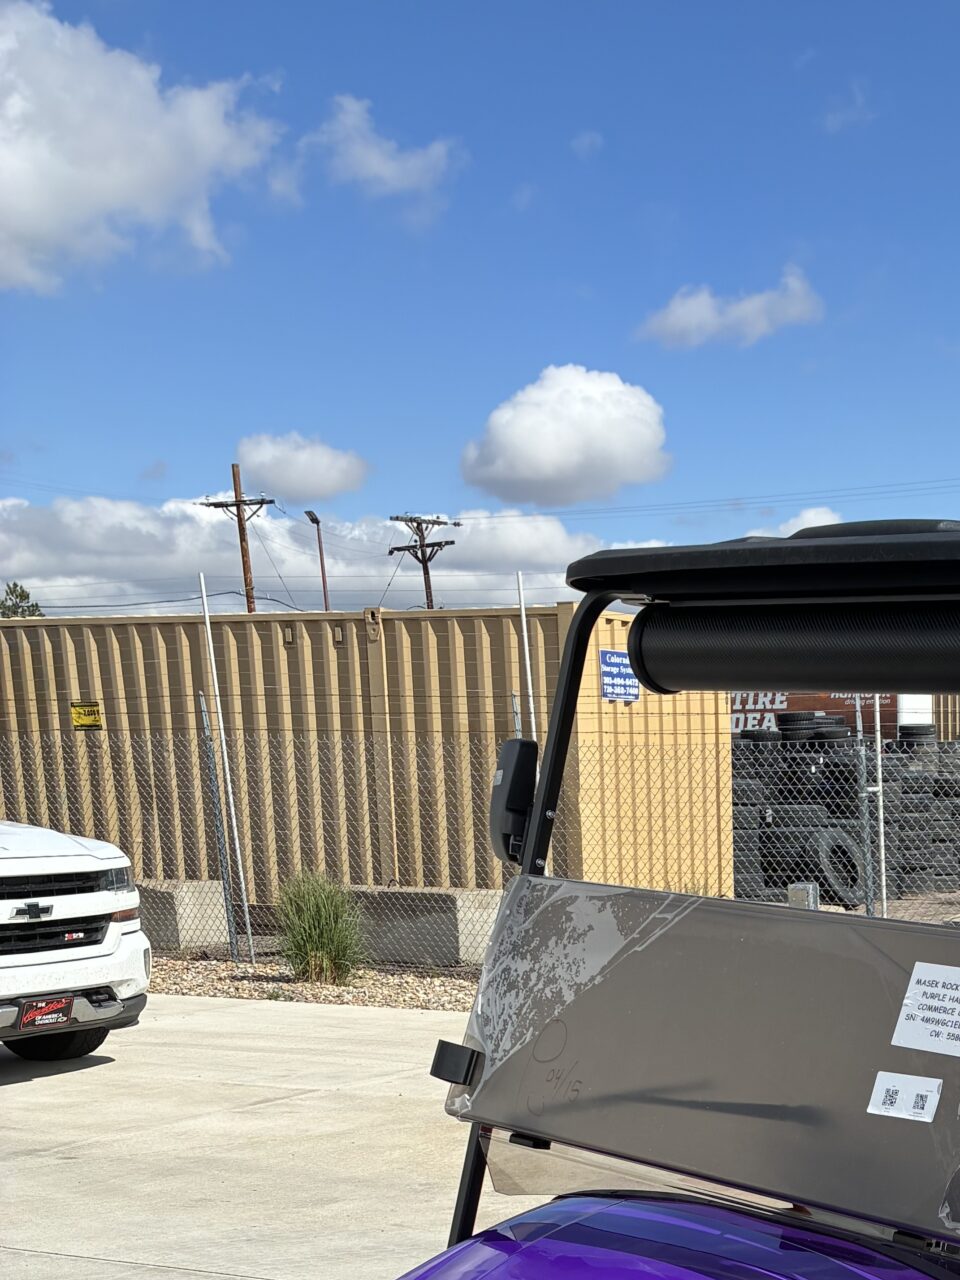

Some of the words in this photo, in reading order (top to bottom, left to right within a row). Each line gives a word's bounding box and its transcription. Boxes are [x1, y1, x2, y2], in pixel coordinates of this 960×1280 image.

[731, 691, 789, 710] TIRE
[914, 977, 940, 989] MASEK
[922, 991, 947, 1002] PURPLE
[917, 1003, 956, 1016] COMMERCE
